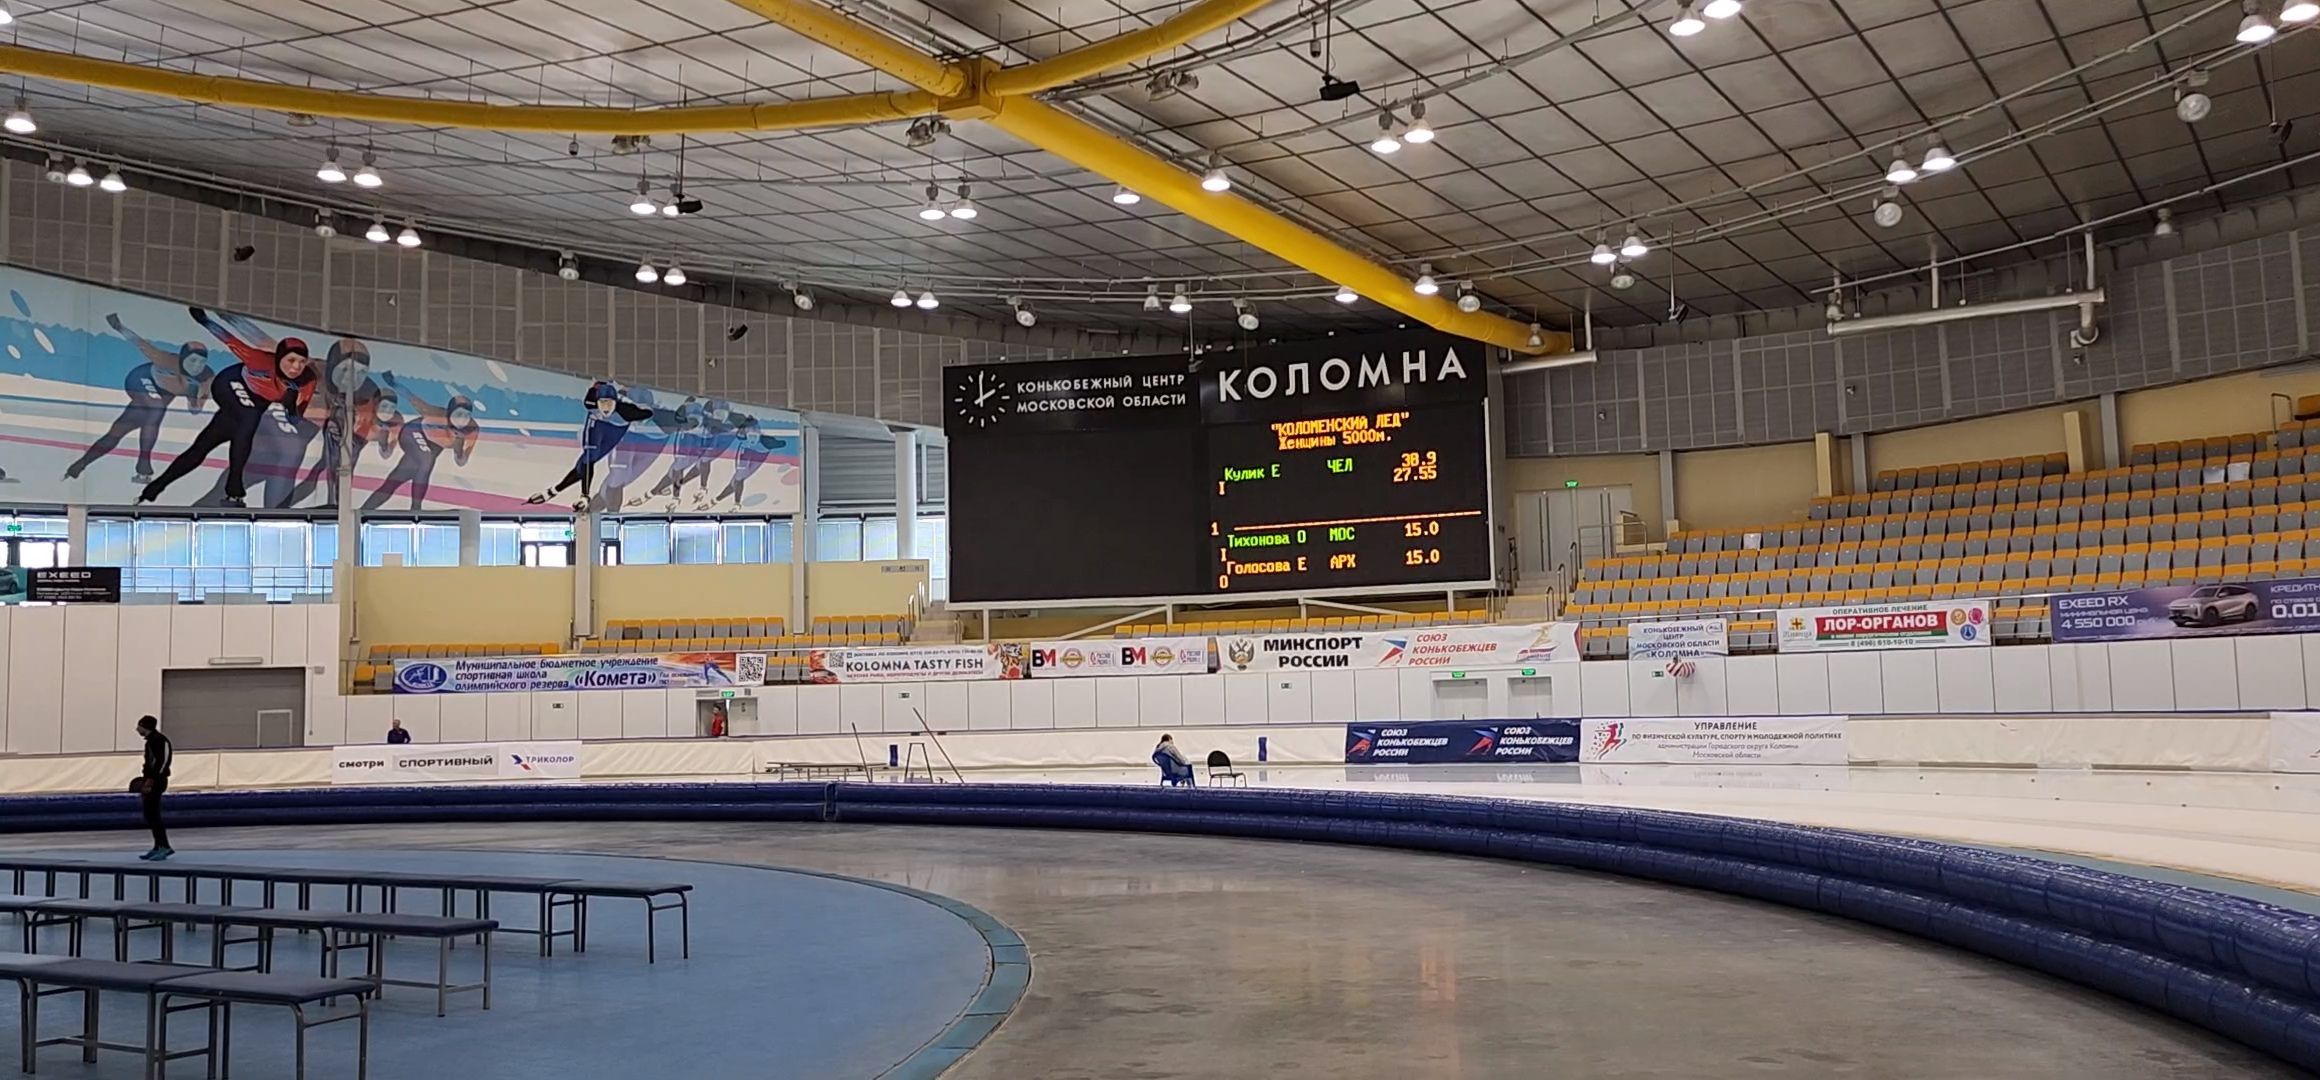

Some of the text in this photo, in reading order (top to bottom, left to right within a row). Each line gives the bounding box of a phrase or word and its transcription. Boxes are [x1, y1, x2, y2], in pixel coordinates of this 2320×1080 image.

[1219, 347, 1467, 402] КОЛОМНА
[1017, 374, 1185, 393] КОНЬКОБЕЖНЫЙ ЦЕНТР
[229, 381, 255, 408] RUS
[1017, 394, 1186, 413] МОСКОВСКОЙ ОБЛАСТИ
[1376, 412, 1410, 429] ЛЕД"
[1278, 433, 1336, 450] Женщины
[1224, 466, 1265, 482] Кулик
[1327, 458, 1353, 473] ЧЕЛ
[1401, 451, 1437, 467] 38.9
[1393, 465, 1437, 482] 27.55
[1211, 522, 1219, 536] 1
[1227, 532, 1290, 549] Тихонова
[1330, 527, 1355, 542] МОС
[1404, 521, 1439, 537] 15.0
[1226, 559, 1291, 575] Голосова
[1330, 554, 1356, 569] АРХ
[1405, 550, 1440, 565] 15.0
[2059, 596, 2129, 609] EXEED RX
[1832, 604, 1928, 615] ОПЕРАТИВНОЕ ЛЕЧЕНИЕ
[1823, 614, 1938, 632] ЛОР-ОРГАНОВ
[2061, 619, 2072, 629] 4
[2074, 617, 2102, 629] 550
[2105, 615, 2135, 627] 000
[1643, 625, 1704, 634] КОНЬКОБЕЖНЫЙ
[1264, 637, 1363, 651] МИНСПОРТ
[1416, 633, 1448, 642] СОЮЗ
[1412, 643, 1497, 654] КОНЬКОБЕЖЦЕВ
[1636, 640, 1719, 649] МОСКОВСКОЙ ОБЛАСТИ
[455, 657, 659, 671] Муниципальное бюджетное учреждение
[846, 658, 983, 672] KOLOMNA TASTY FISH
[1279, 655, 1349, 668] РОССИИ
[1408, 657, 1451, 665] РОССИИ
[455, 670, 548, 682] спортивная школа
[574, 670, 656, 687] «Комета»
[455, 680, 569, 691] олимпийского резерва
[1381, 728, 1408, 737] СОЮЗ
[1504, 726, 1532, 735] СОЮЗ
[1694, 722, 1758, 730] УПРАВЛЕНИЕ
[1377, 738, 1448, 747] КОНЬКОБЕЖЦЕВ
[1500, 736, 1574, 746] КОНЬКОБЕЖЦЕВ
[1495, 747, 1533, 755] РОССИИ
[338, 759, 385, 769] смотри
[399, 755, 493, 768] СПОРТИВНЫЙ
[526, 756, 574, 764] ТРИКОЛОР
